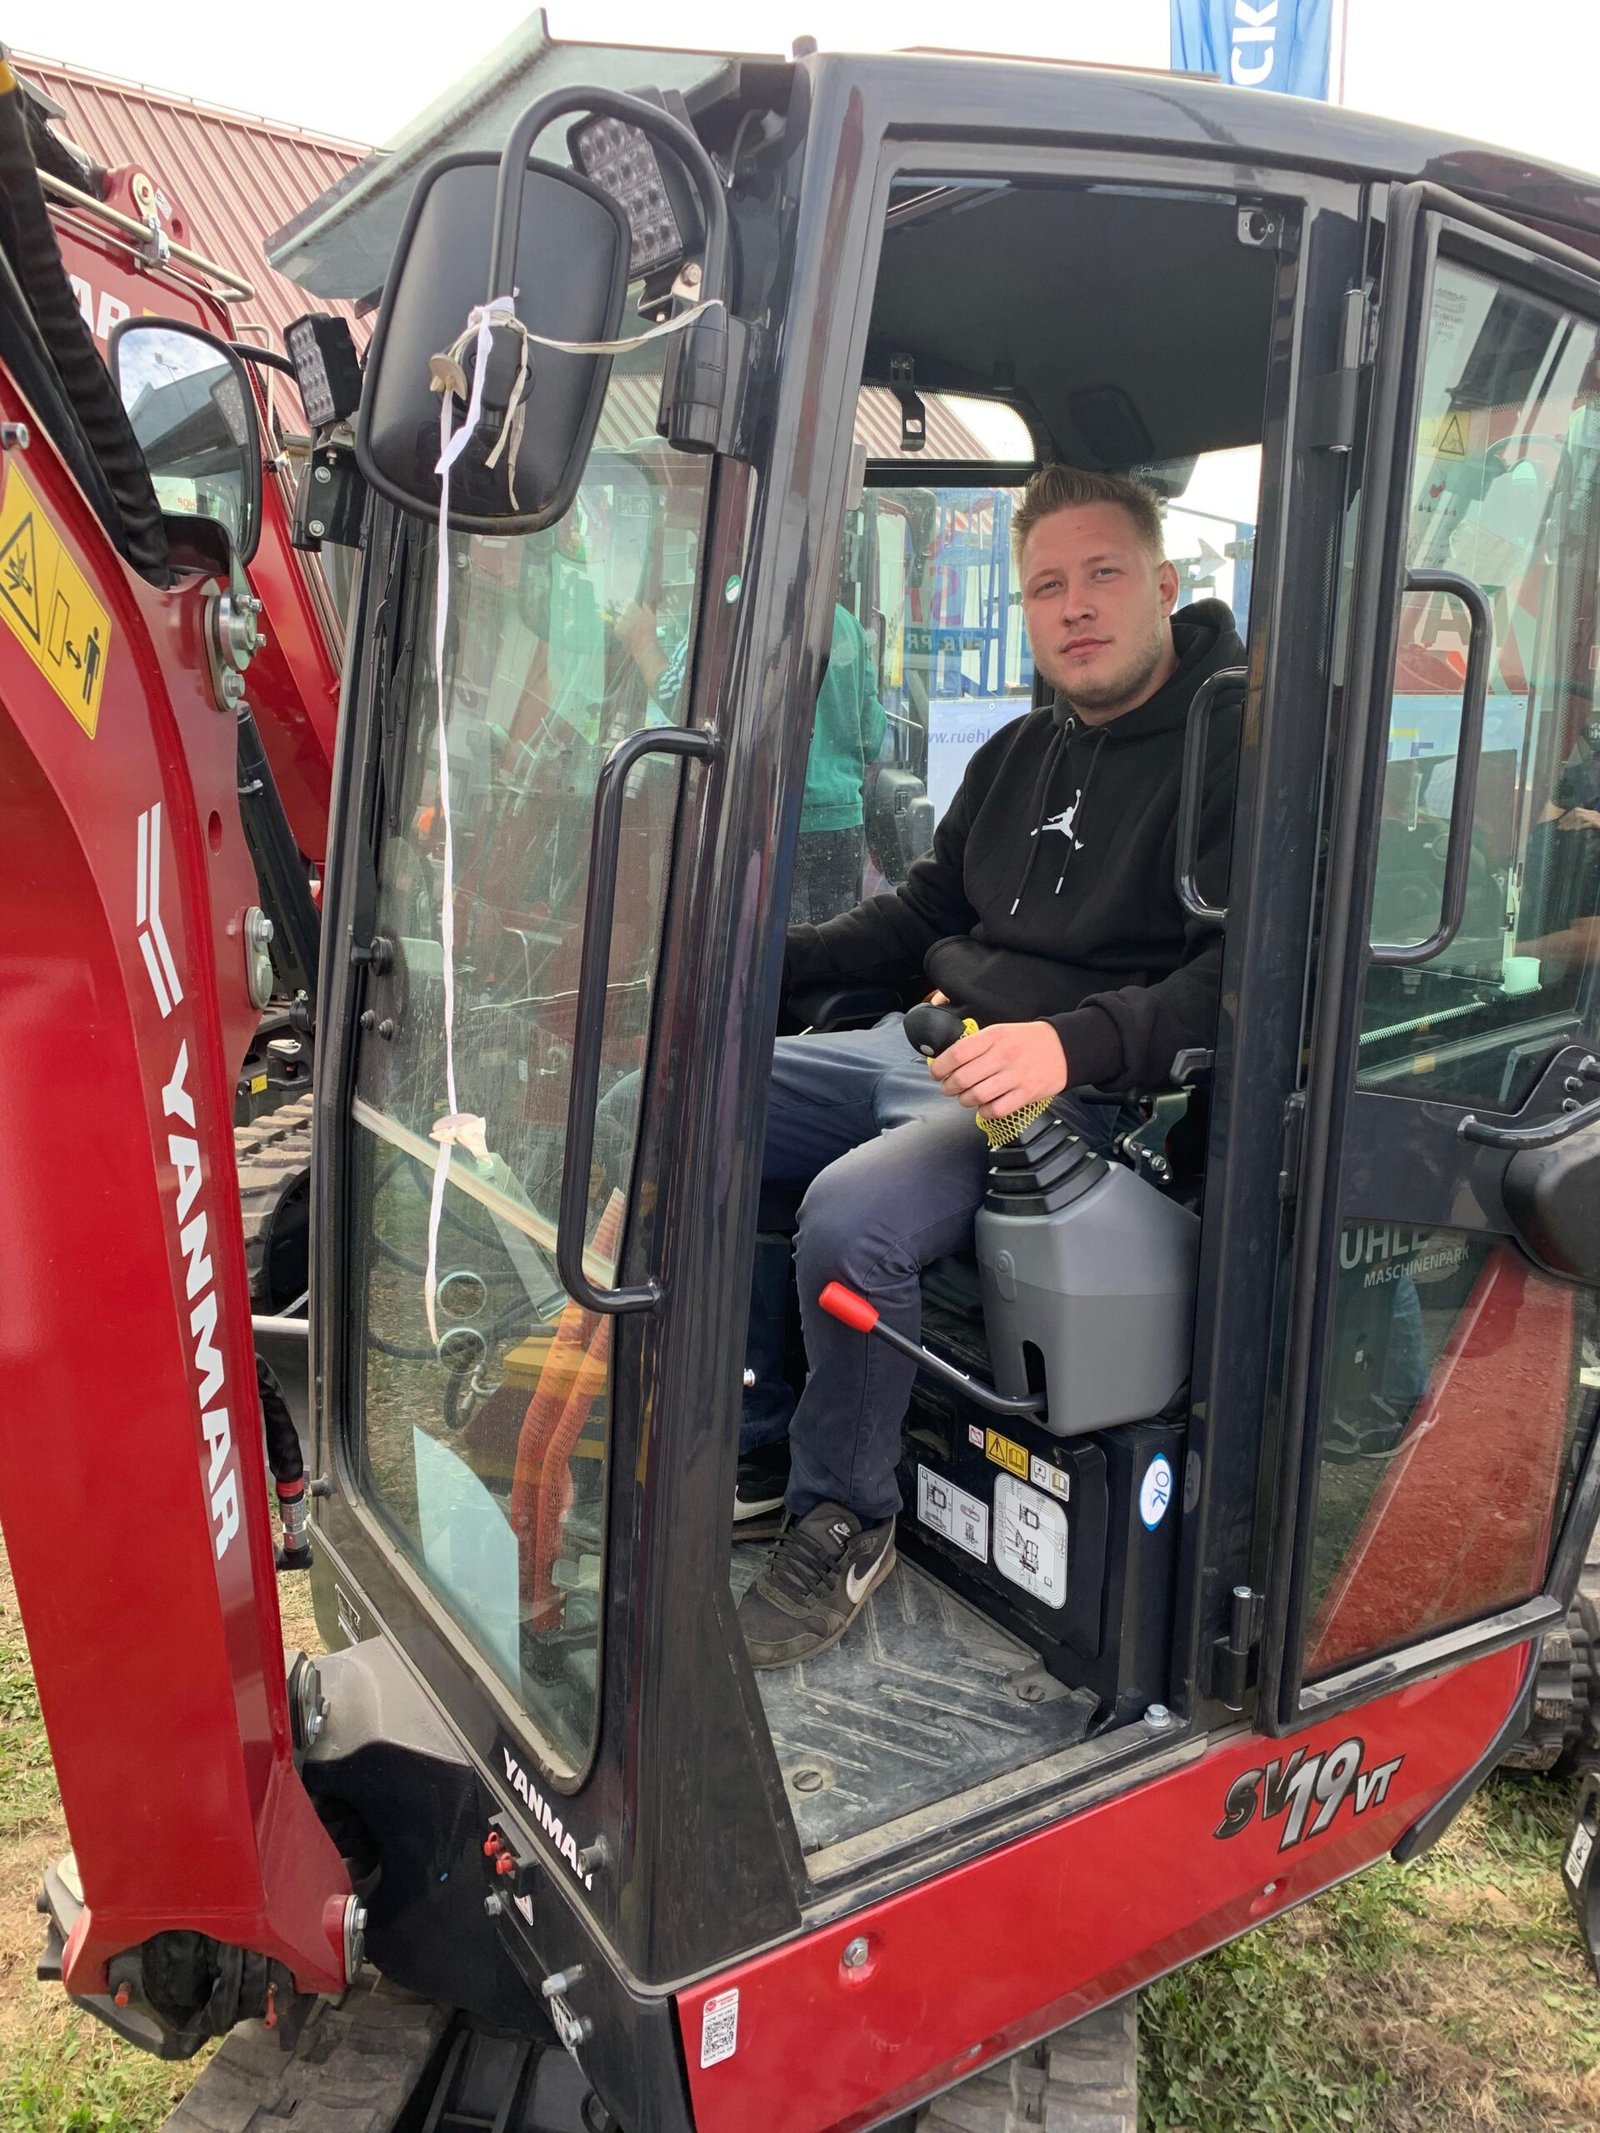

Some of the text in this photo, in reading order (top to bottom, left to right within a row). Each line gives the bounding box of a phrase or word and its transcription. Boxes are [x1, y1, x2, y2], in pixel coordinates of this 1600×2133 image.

[1363, 1245, 1469, 1289] MASCHINENPARK
[161, 1038, 240, 1561] YANMAR
[1152, 1471, 1170, 1508] OK
